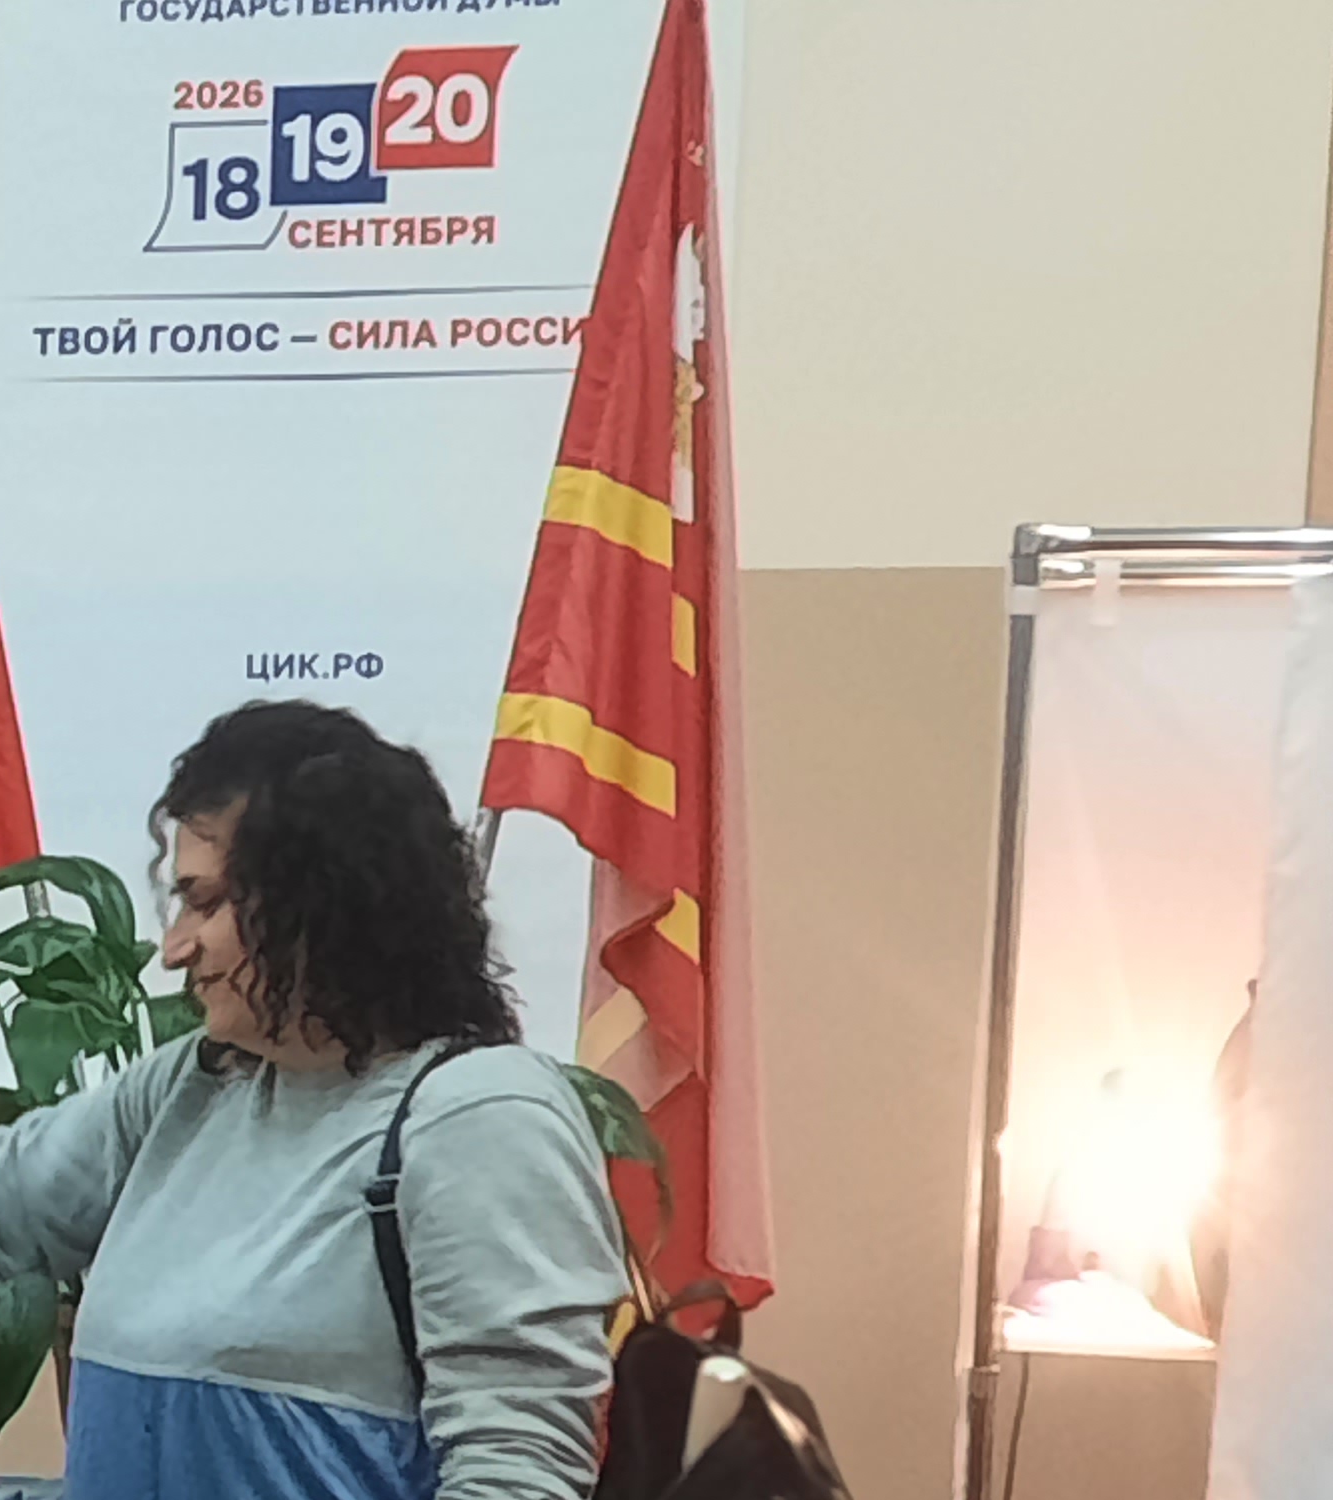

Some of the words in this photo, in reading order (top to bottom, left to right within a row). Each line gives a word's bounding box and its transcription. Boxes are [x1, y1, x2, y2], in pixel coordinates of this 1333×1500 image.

[173, 79, 264, 110] 2026
[183, 156, 261, 221] 18
[281, 112, 365, 183] 19
[384, 73, 491, 146] 20
[288, 215, 496, 249] СЕНТЯБРЯ
[33, 319, 136, 356] ТВОЙ
[148, 323, 280, 355] ГОЛОС
[328, 319, 437, 350] СИЛА
[245, 652, 384, 684] ЦИК.РФ
